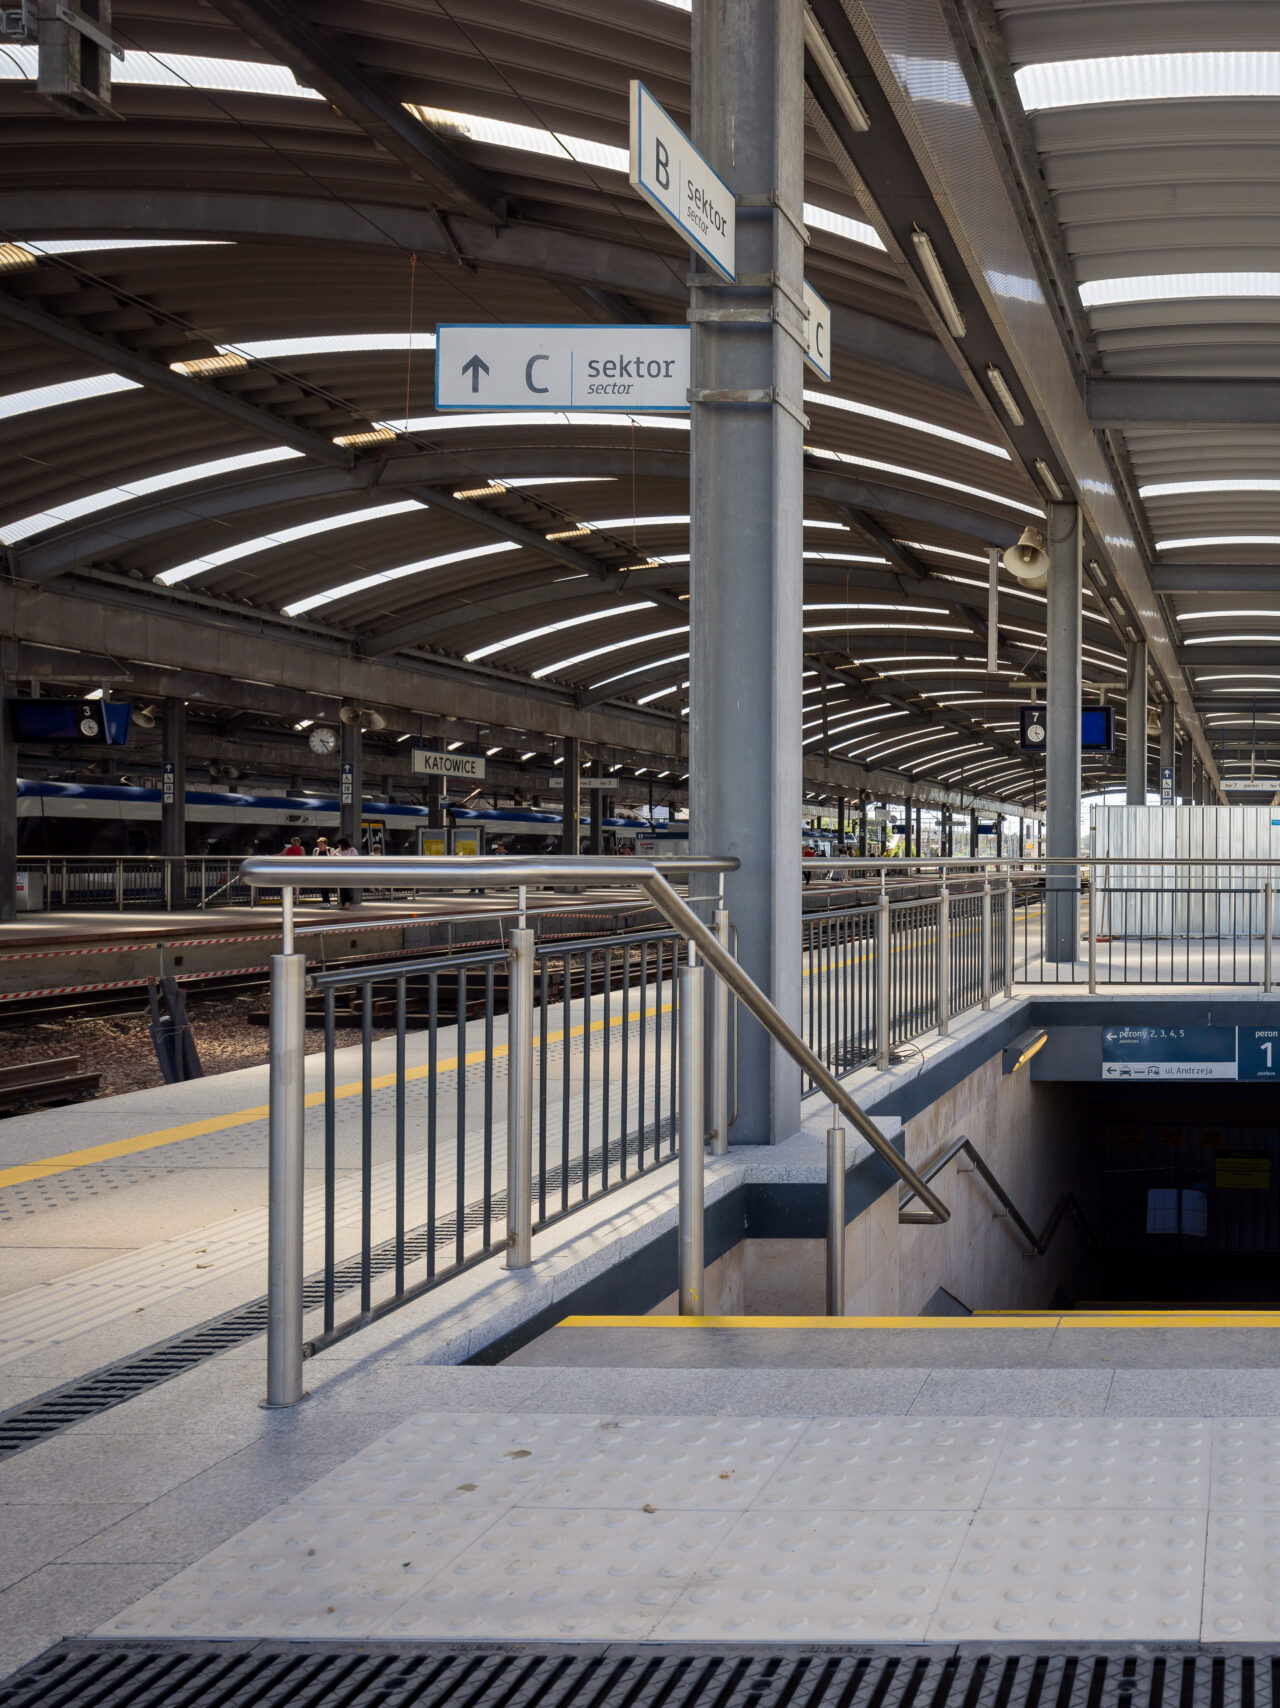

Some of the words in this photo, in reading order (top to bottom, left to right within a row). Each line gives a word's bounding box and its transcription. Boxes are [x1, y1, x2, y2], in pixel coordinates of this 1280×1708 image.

[655, 136, 670, 191] B
[687, 179, 728, 237] sektor
[687, 206, 709, 235] sector
[815, 321, 824, 358] C
[525, 354, 550, 394] C
[587, 354, 675, 378] sektor
[587, 382, 634, 395] sector
[83, 706, 91, 716] 3
[1032, 712, 1040, 722] 7
[424, 755, 476, 774] KATOWICE
[1119, 1031, 1148, 1039] perony
[1150, 1030, 1157, 1038] 2,
[1160, 1030, 1167, 1038] 3,
[1170, 1030, 1177, 1038] 4,
[1255, 1030, 1278, 1038] peron
[1260, 1042, 1272, 1068] 1
[1165, 1067, 1175, 1075] ul.
[1176, 1067, 1213, 1076] Andrzeja
